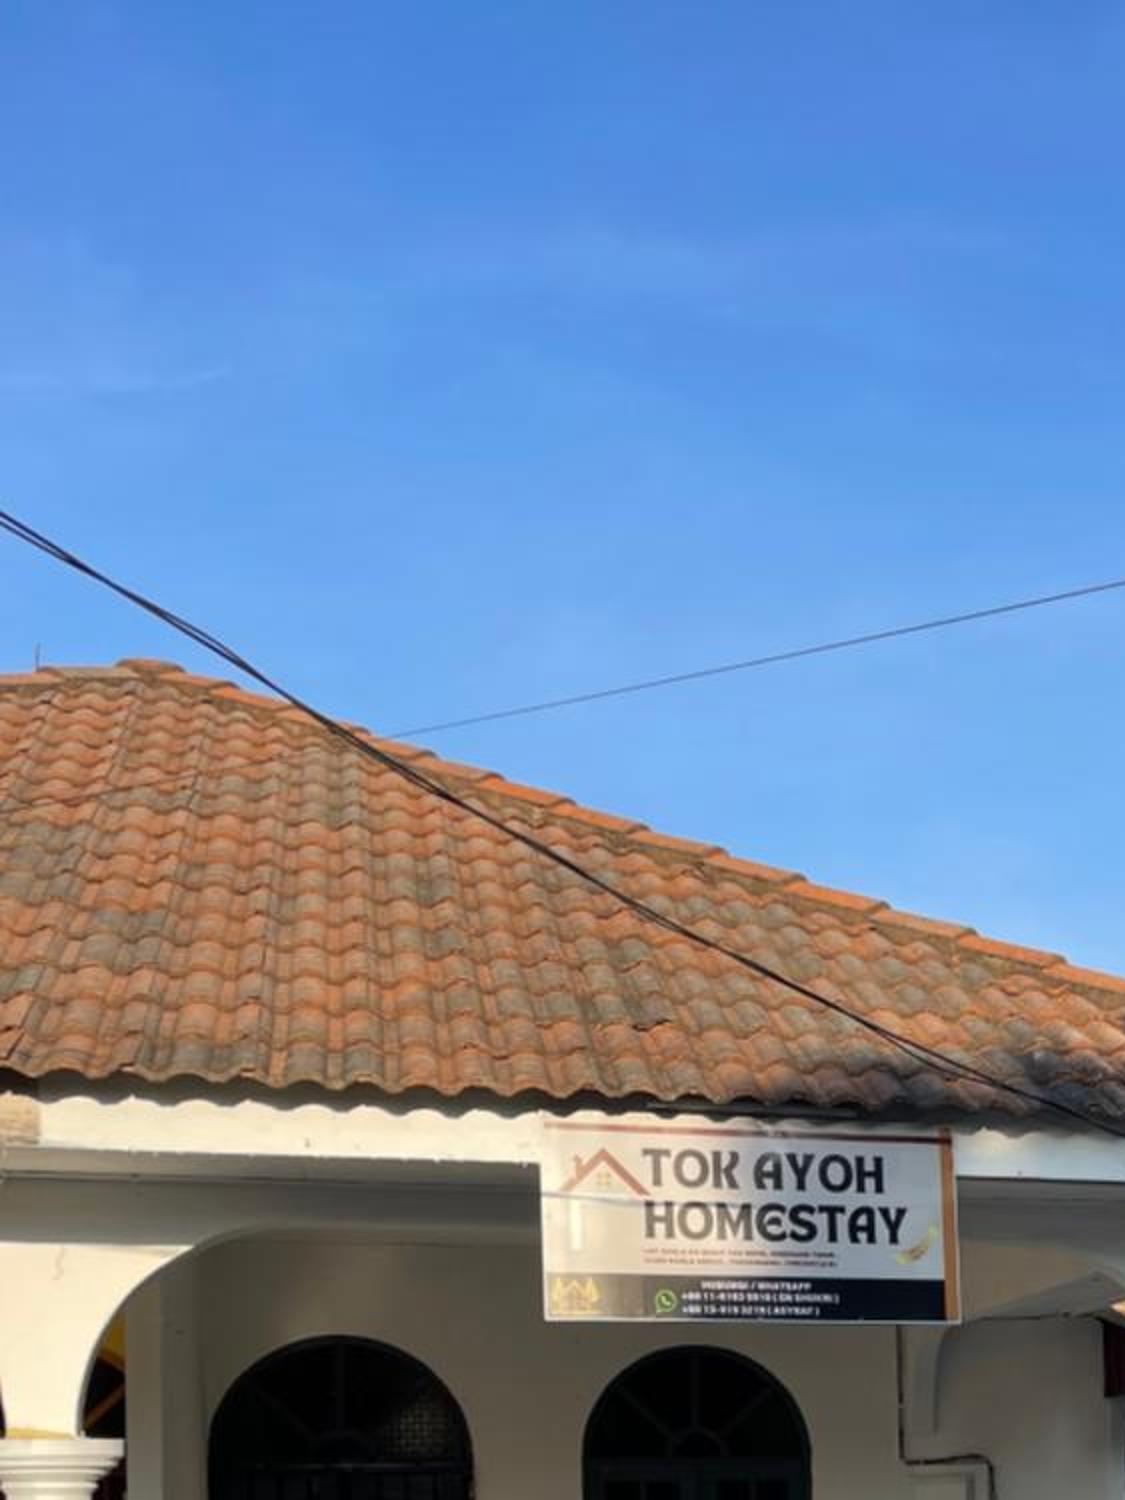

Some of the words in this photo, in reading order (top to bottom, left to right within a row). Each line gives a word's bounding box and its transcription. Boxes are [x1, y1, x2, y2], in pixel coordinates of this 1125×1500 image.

[641, 1148, 740, 1190] TOK
[753, 1151, 884, 1194] AYOH
[644, 1201, 908, 1246] HOMESTAY
